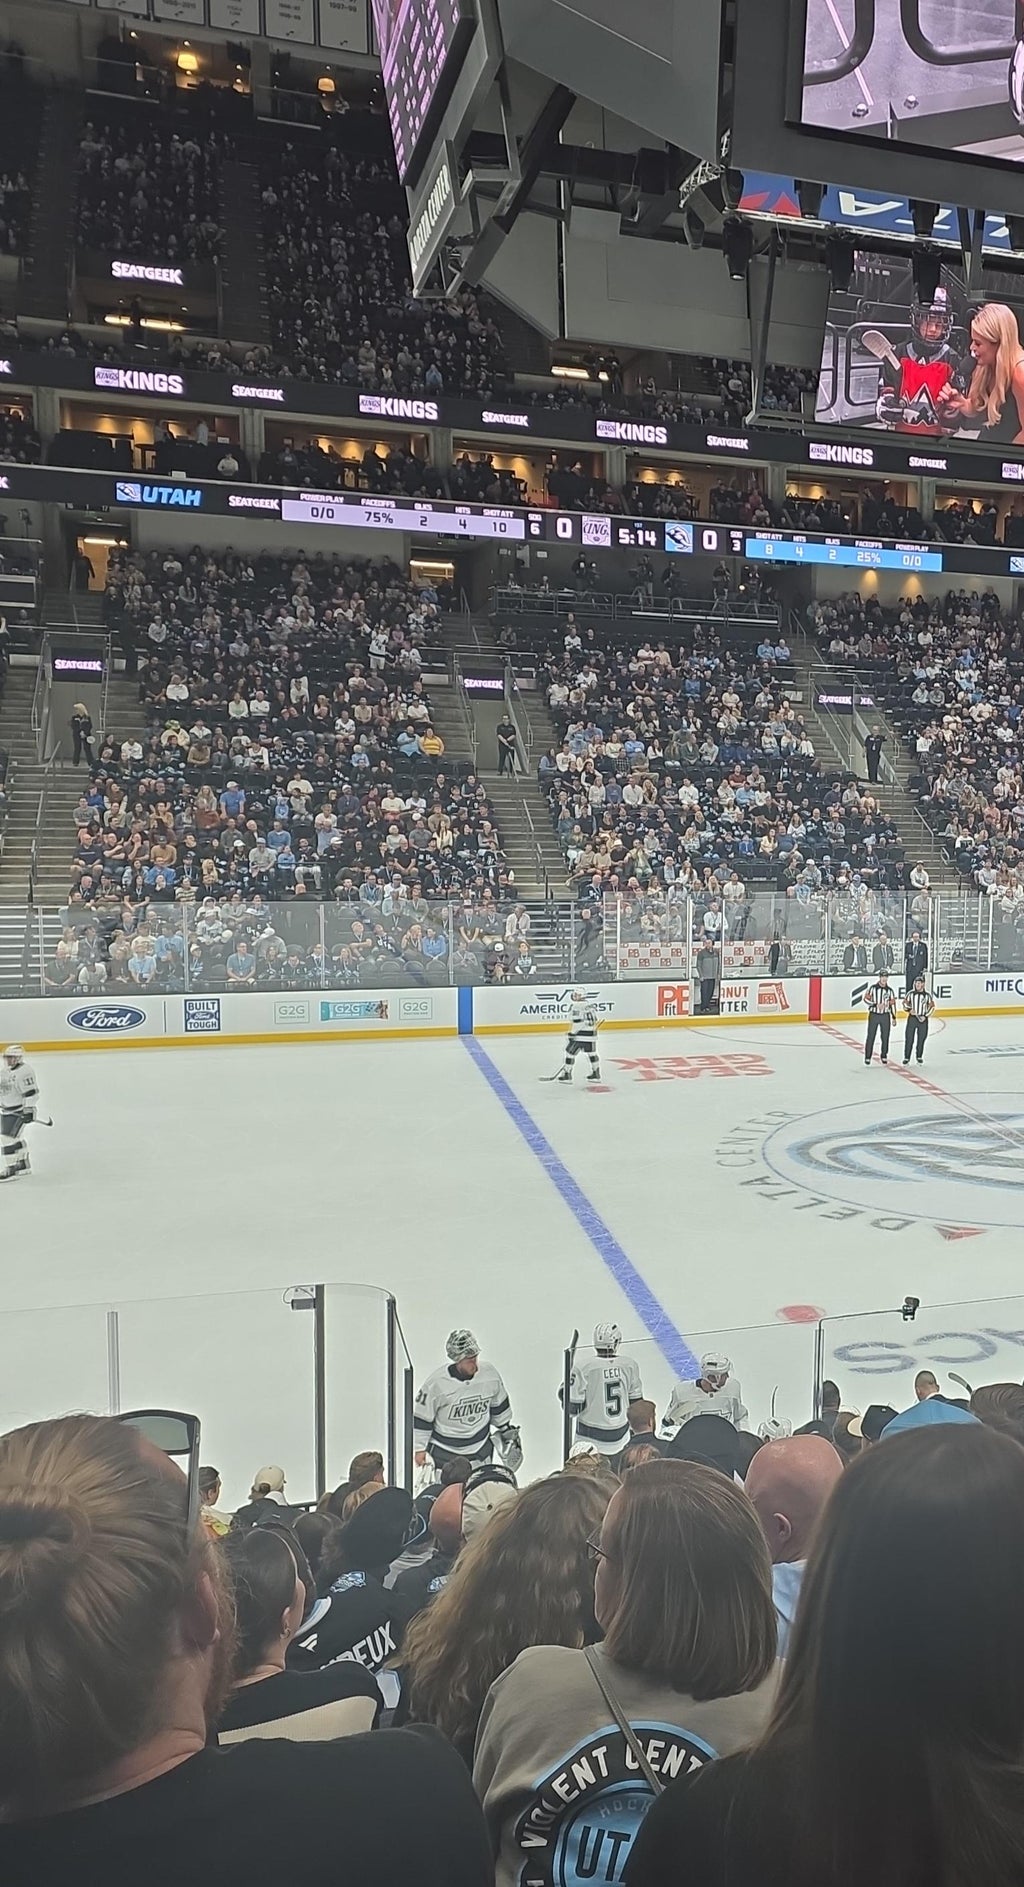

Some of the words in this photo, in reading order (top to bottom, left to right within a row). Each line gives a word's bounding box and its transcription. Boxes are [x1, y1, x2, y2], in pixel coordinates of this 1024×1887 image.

[111, 260, 184, 286] SEATGEEK
[119, 369, 184, 395] KINGS
[231, 384, 285, 402] SEATGEEK
[380, 397, 439, 421] KINGS
[482, 411, 530, 427] SEATGEEK
[616, 421, 668, 444] KINGS
[707, 434, 749, 450] SEATGEEK
[827, 444, 874, 466] KINGS
[909, 456, 947, 471] SEATGEEK
[142, 485, 202, 507] UTAH
[228, 495, 280, 511] SEATGEEK
[310, 506, 335, 520] 0/0
[364, 511, 394, 525] 75%
[420, 515, 428, 527] 2
[459, 518, 467, 530] 4
[492, 521, 507, 533] 10
[556, 517, 573, 539] 0
[530, 523, 540, 535] 6
[618, 528, 657, 547] 5:14
[702, 529, 718, 551] 0
[732, 539, 741, 551] 3
[795, 545, 803, 557] 4
[829, 549, 836, 560] 2
[857, 551, 881, 564] 25%
[903, 554, 922, 567] 0/0
[55, 657, 103, 672] SEATGEEK
[463, 678, 504, 690] SEATGEEK
[720, 985, 749, 999] ANUT
[187, 1001, 217, 1011] BUILT
[278, 1006, 305, 1016] G2G
[335, 1004, 360, 1014] G2G
[403, 1002, 428, 1012] G2G
[665, 1003, 677, 1016] fit
[720, 1000, 748, 1013] TTER
[81, 1008, 132, 1028] Ford
[188, 1021, 217, 1030] TOUGH
[606, 1053, 767, 1070] GEEK
[715, 1110, 805, 1168] CENTER
[738, 1175, 917, 1231] DELTA
[603, 1367, 621, 1379] CECI
[604, 1380, 622, 1417] 5
[453, 1399, 490, 1418] KINGS
[520, 1746, 609, 1849] VIOLENT
